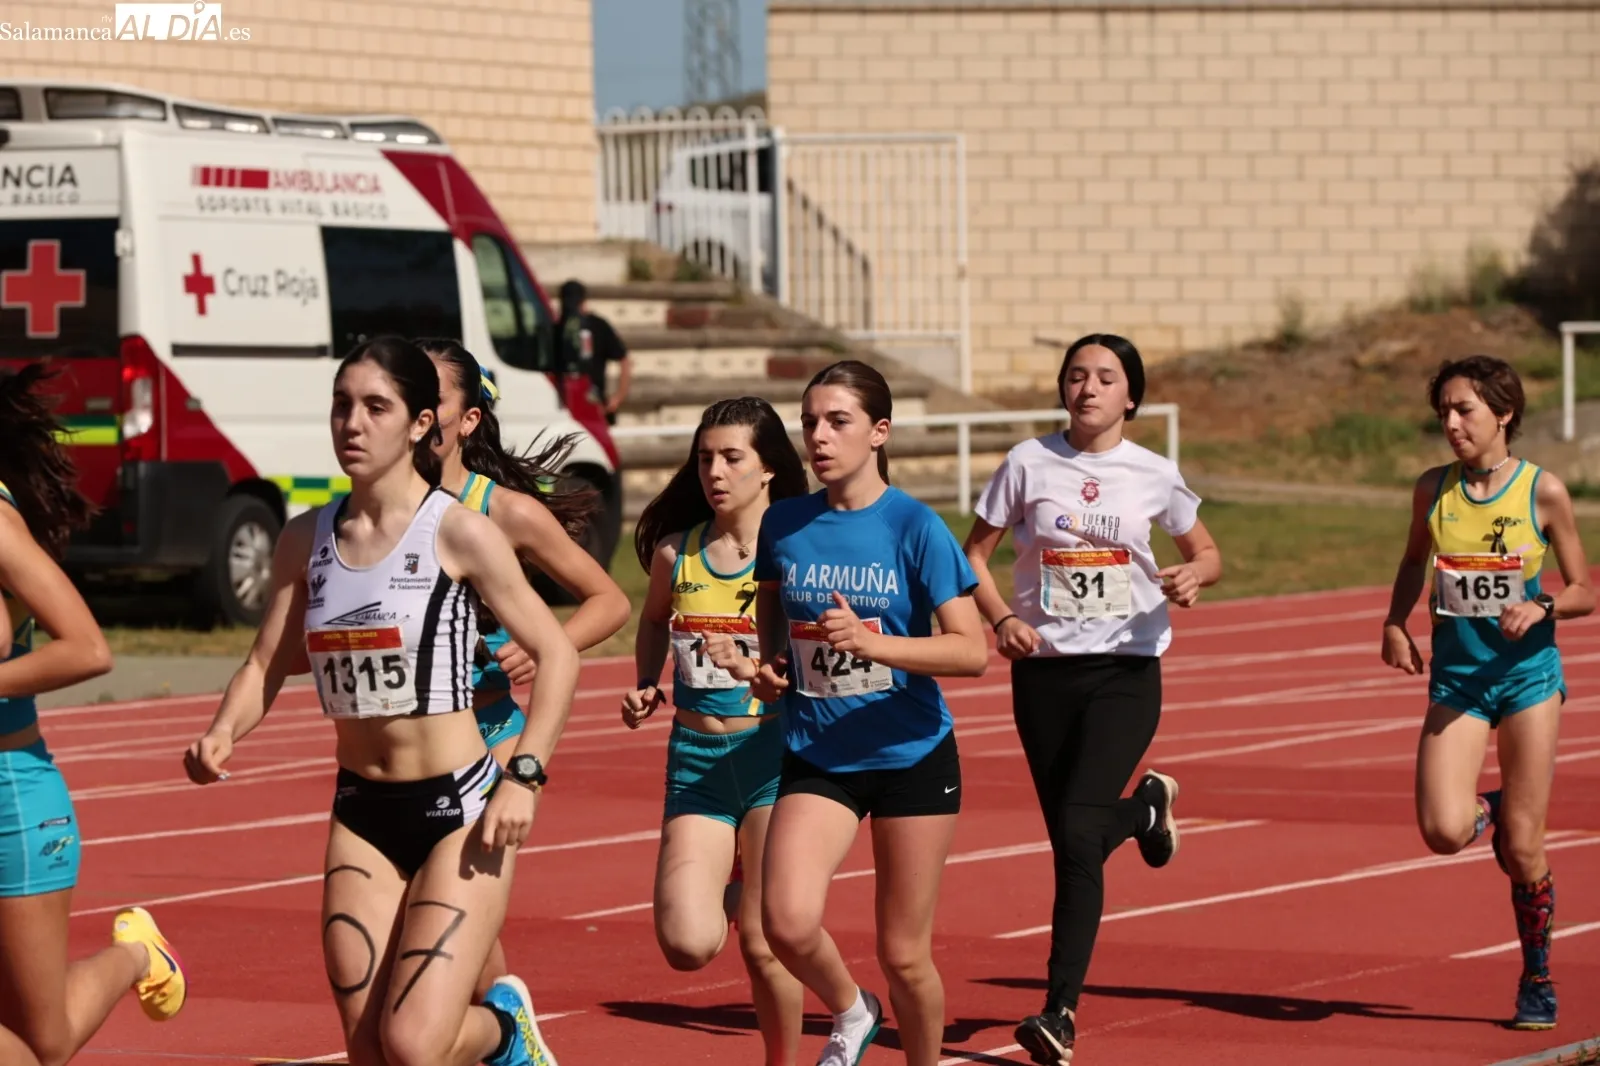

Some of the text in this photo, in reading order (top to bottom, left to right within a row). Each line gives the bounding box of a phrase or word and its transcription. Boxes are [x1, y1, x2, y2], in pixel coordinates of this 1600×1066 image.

[273, 170, 382, 193] AMBULANCIA
[223, 267, 319, 308] Cruz Roja
[1082, 513, 1120, 528] LUENGO
[390, 576, 431, 584] Ayuntamiento
[802, 563, 899, 595] ARMUÑA
[1071, 571, 1104, 599] 31
[1455, 575, 1510, 600] 165
[786, 591, 890, 609] CLUB DEORTIVO
[323, 654, 406, 694] 1315
[425, 808, 461, 818] VIATOR
